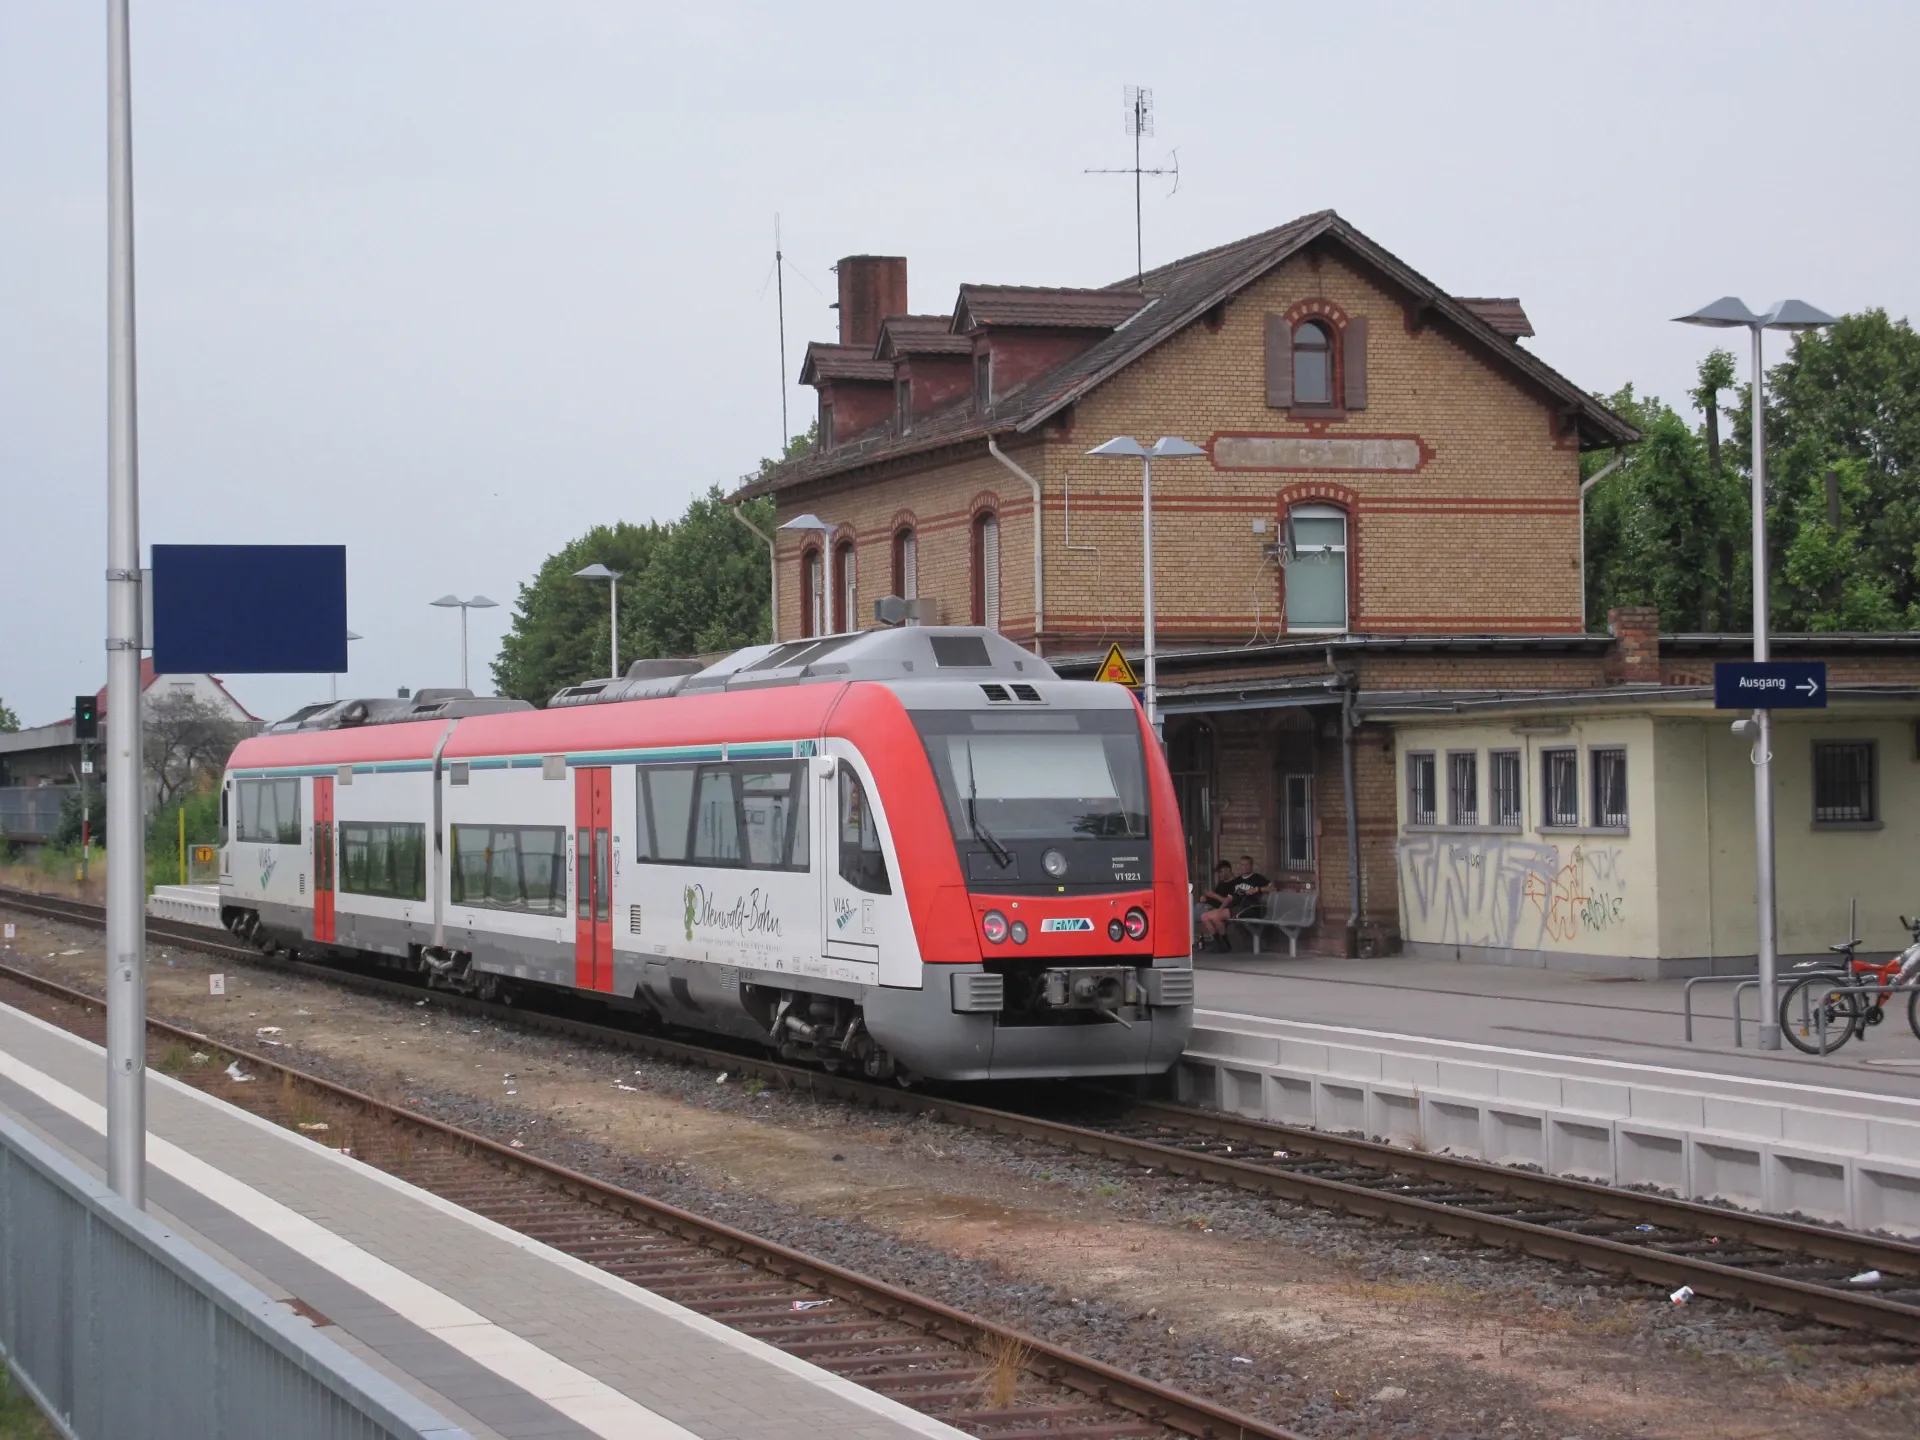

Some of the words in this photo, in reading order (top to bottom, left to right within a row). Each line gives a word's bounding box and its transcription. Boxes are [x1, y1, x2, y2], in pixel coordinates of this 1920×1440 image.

[1739, 677, 1786, 690] Ausgang
[833, 897, 851, 915] VIAS
[1053, 919, 1084, 931] RMV
